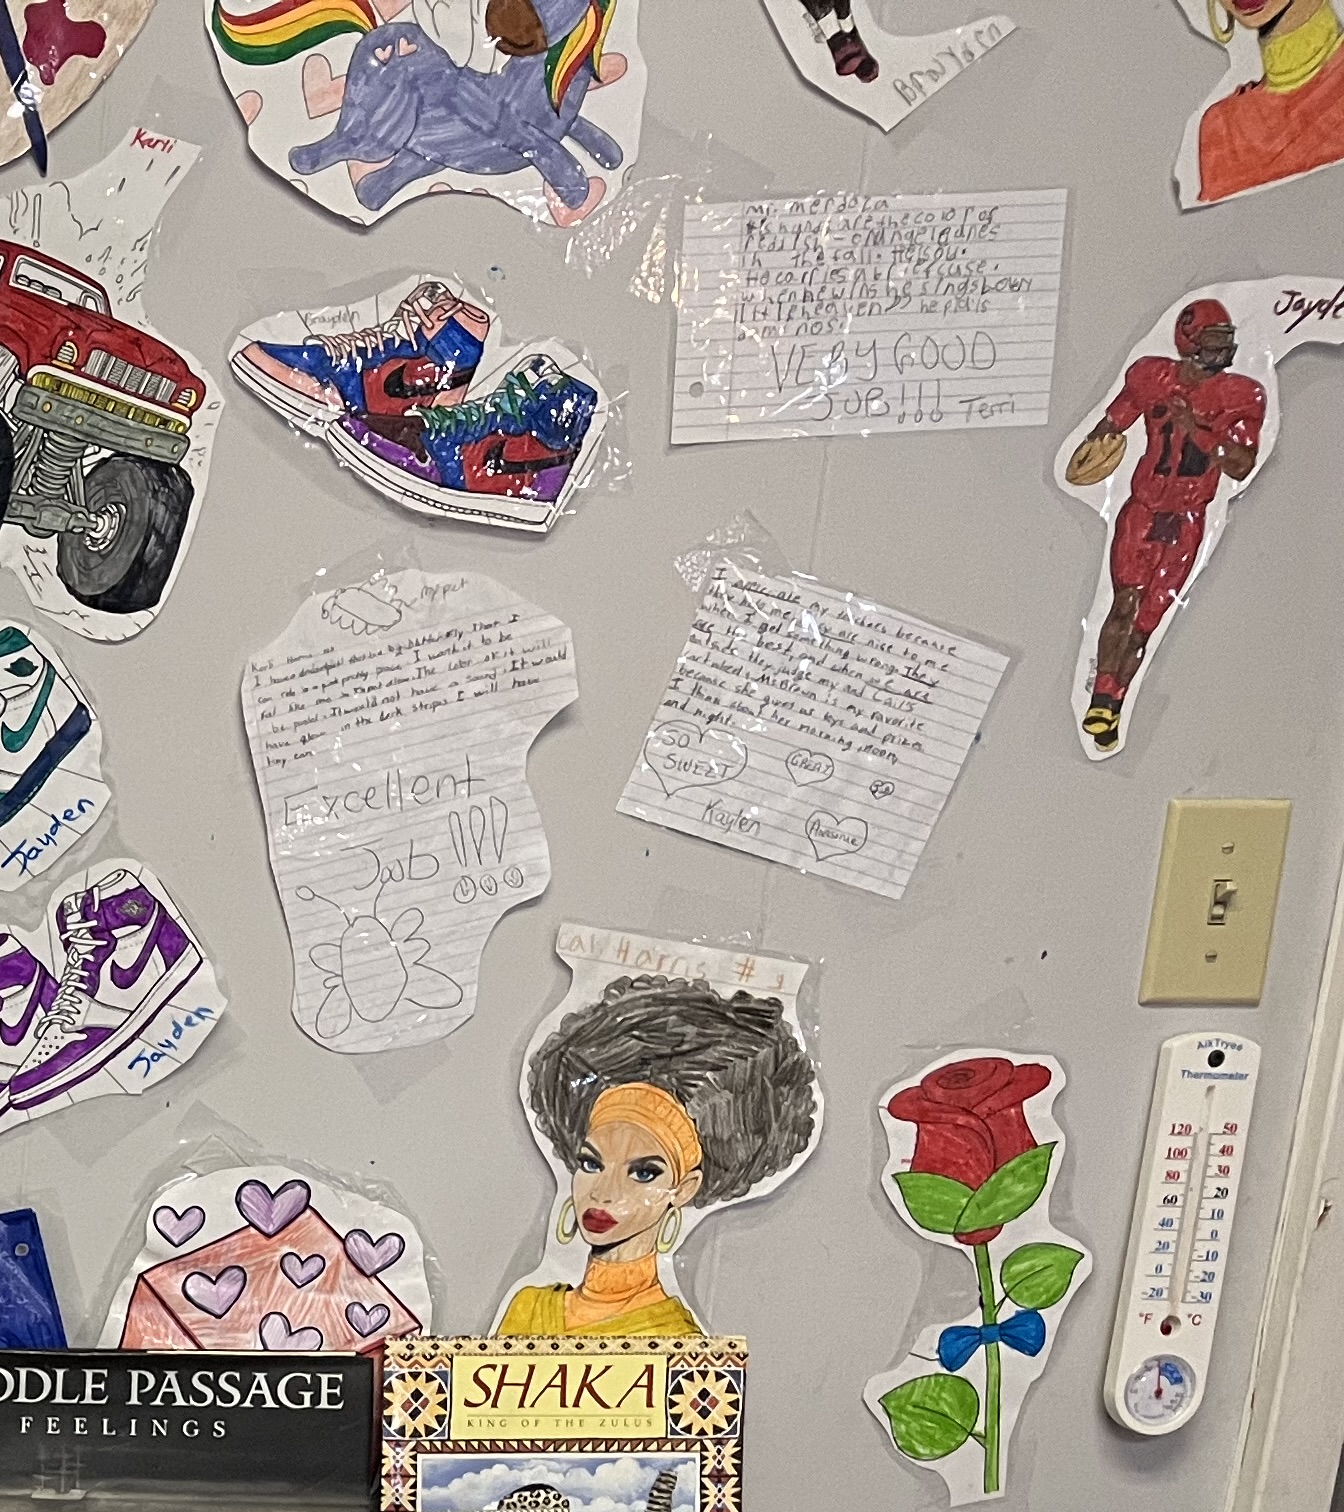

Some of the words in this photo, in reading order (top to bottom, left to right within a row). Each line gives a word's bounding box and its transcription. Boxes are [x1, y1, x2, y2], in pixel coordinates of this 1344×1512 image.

[893, 330, 997, 376] GOOD
[284, 752, 486, 826] Excellent
[1, 798, 95, 876] Jayden
[128, 1006, 214, 1078] Jayden
[1180, 1068, 1250, 1081] Thermometer
[1169, 1122, 1193, 1136] 120
[1222, 1121, 1238, 1135] 50
[1164, 1146, 1188, 1160] 100
[1218, 1144, 1234, 1157] 40
[1164, 1169, 1181, 1182] 80
[1214, 1164, 1231, 1178] 30
[1162, 1193, 1179, 1206] 60
[1213, 1186, 1229, 1199] 20
[1158, 1216, 1174, 1229] 40
[1210, 1208, 1225, 1220] 10
[1154, 1240, 1170, 1252] 20
[1196, 1249, 1219, 1262] -10
[1140, 1286, 1164, 1299] -20
[1193, 1270, 1216, 1283] -20
[125, 1368, 346, 1411] PASSAGE
[462, 1363, 655, 1409] SHAKA
[19, 1416, 228, 1439] FEELINGS
[467, 1418, 508, 1428] KING
[520, 1418, 541, 1428] OF
[554, 1418, 586, 1428] THE
[598, 1418, 654, 1428] ZULUS
